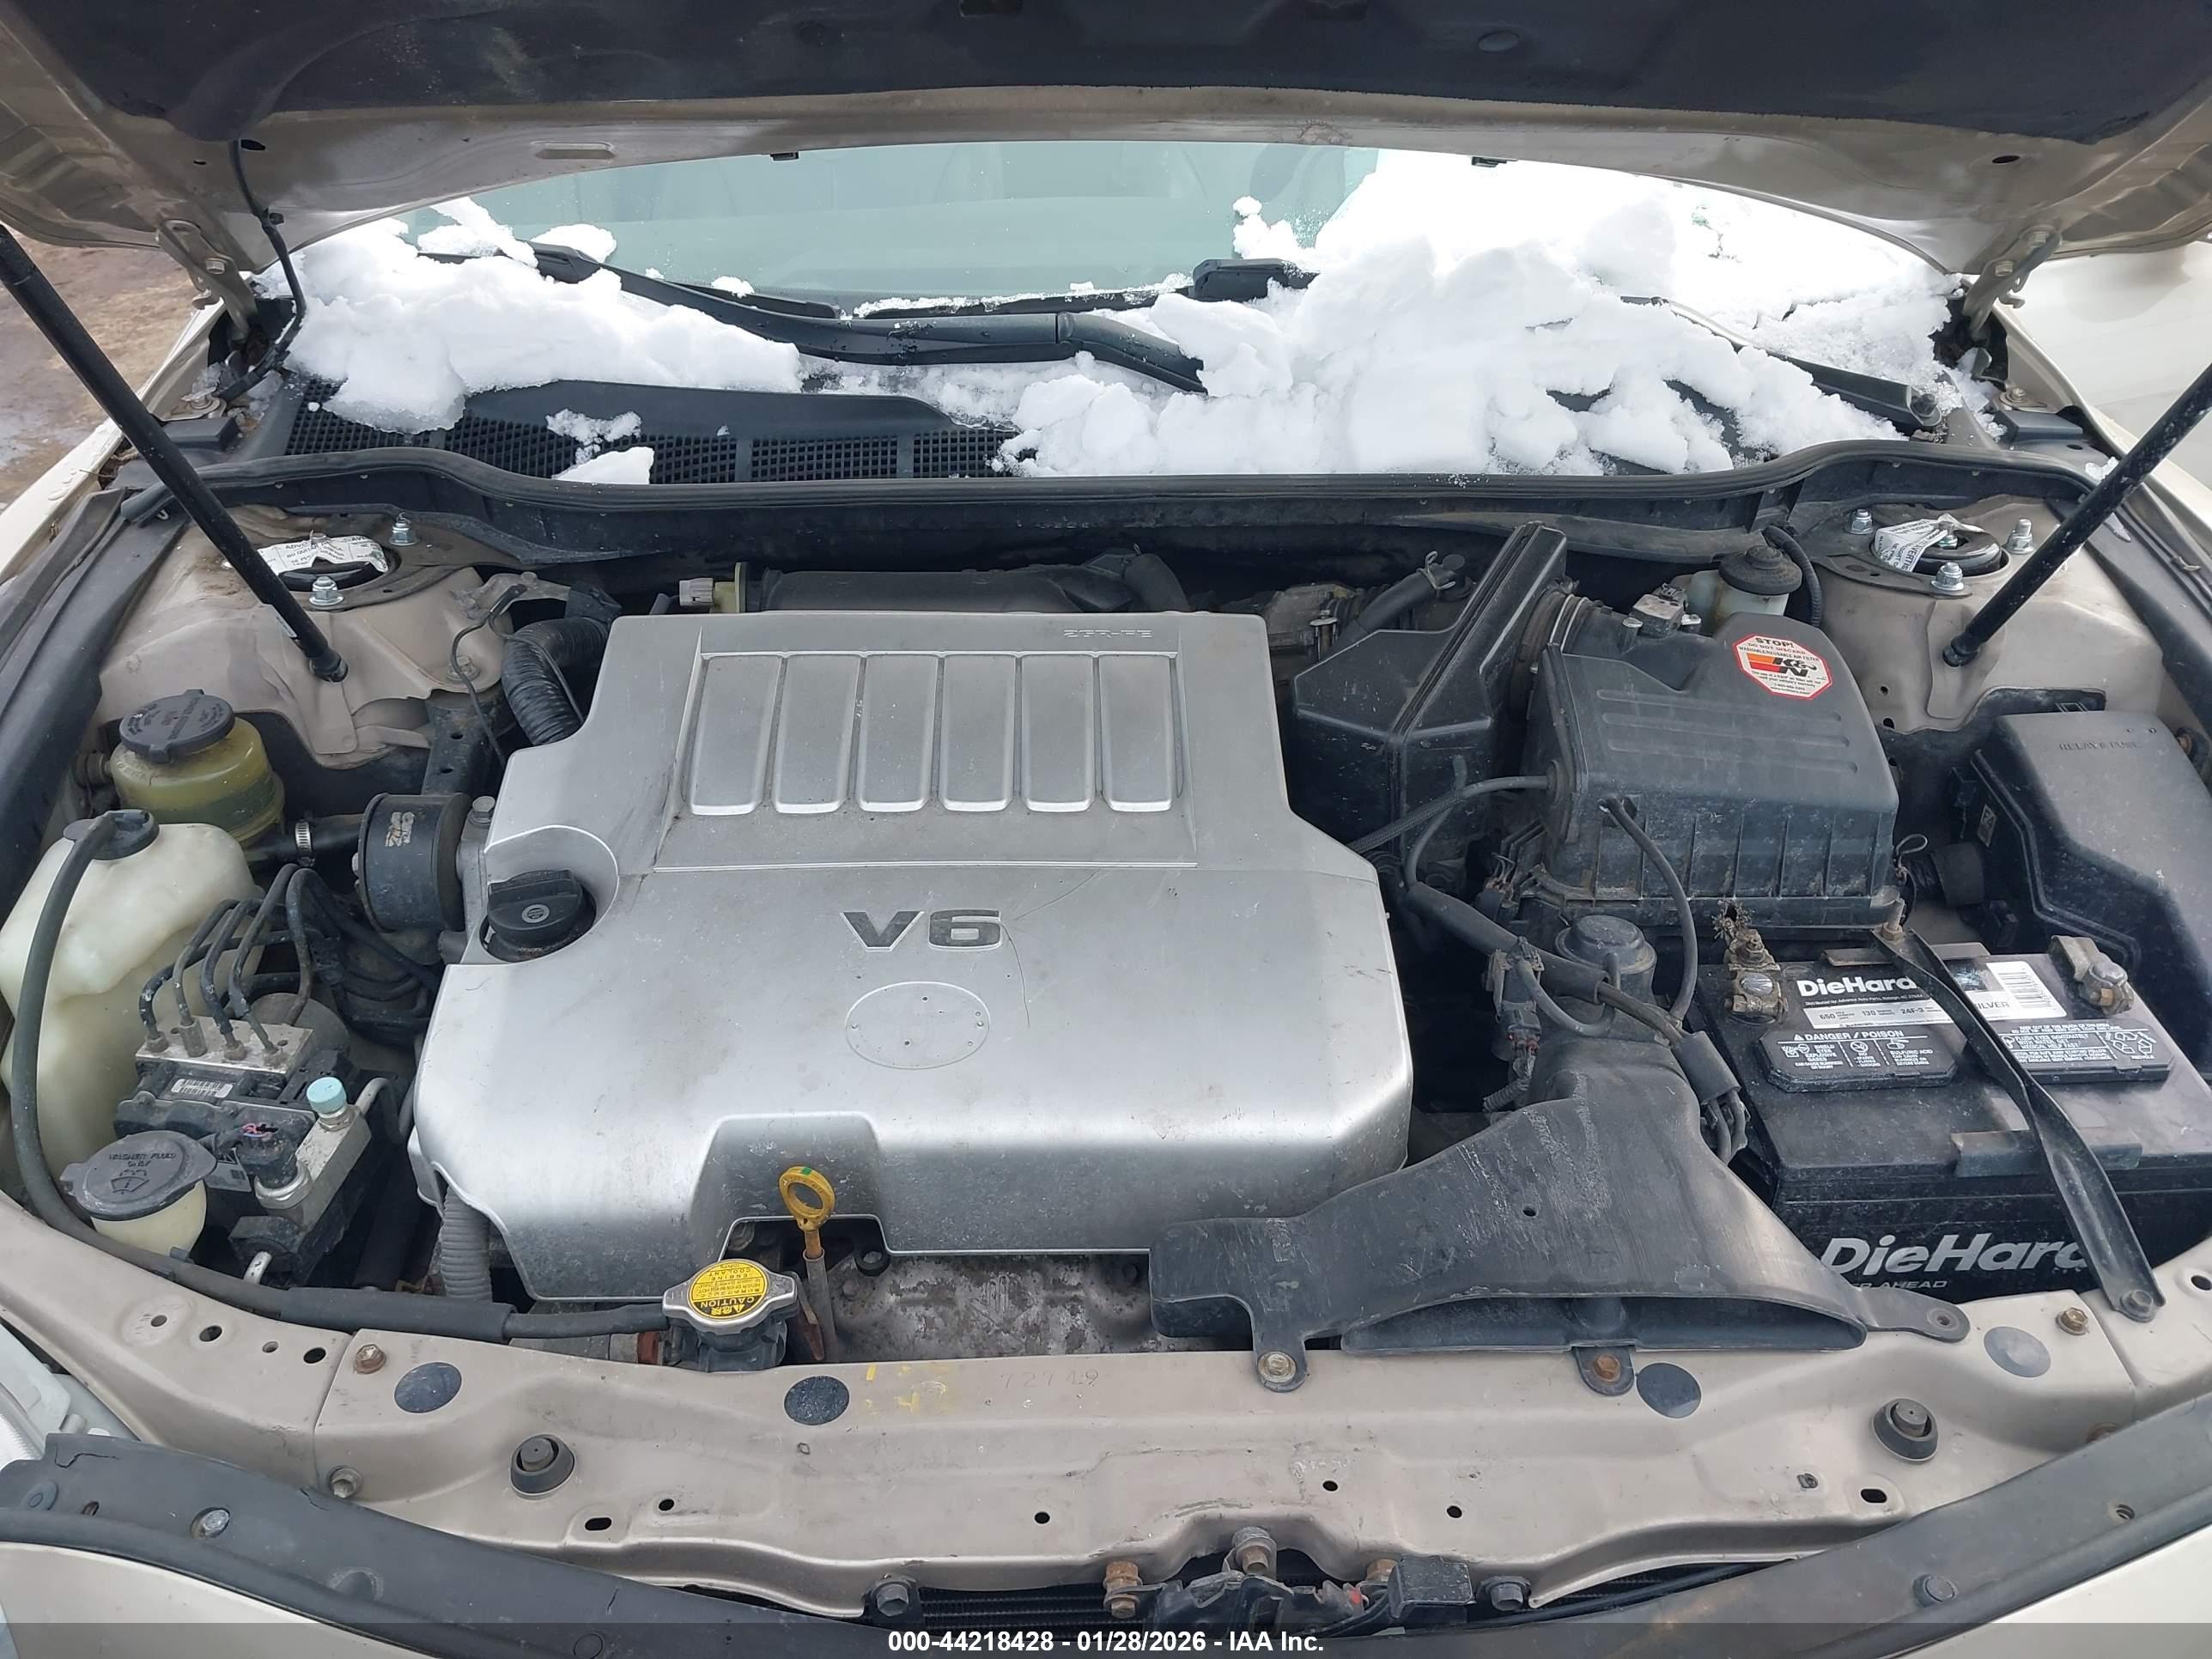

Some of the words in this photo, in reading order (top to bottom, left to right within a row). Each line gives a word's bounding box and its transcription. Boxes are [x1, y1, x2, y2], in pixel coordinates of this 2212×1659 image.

[1755, 637, 1794, 648] STOP!
[839, 909, 1001, 951] V6
[1976, 1001, 2010, 1012] ILVER
[1861, 1030, 1905, 1039] POISON
[708, 1267, 751, 1276] COOLANT
[1880, 1279, 1948, 1289] AHEAD
[700, 1296, 755, 1309] CAUTION
